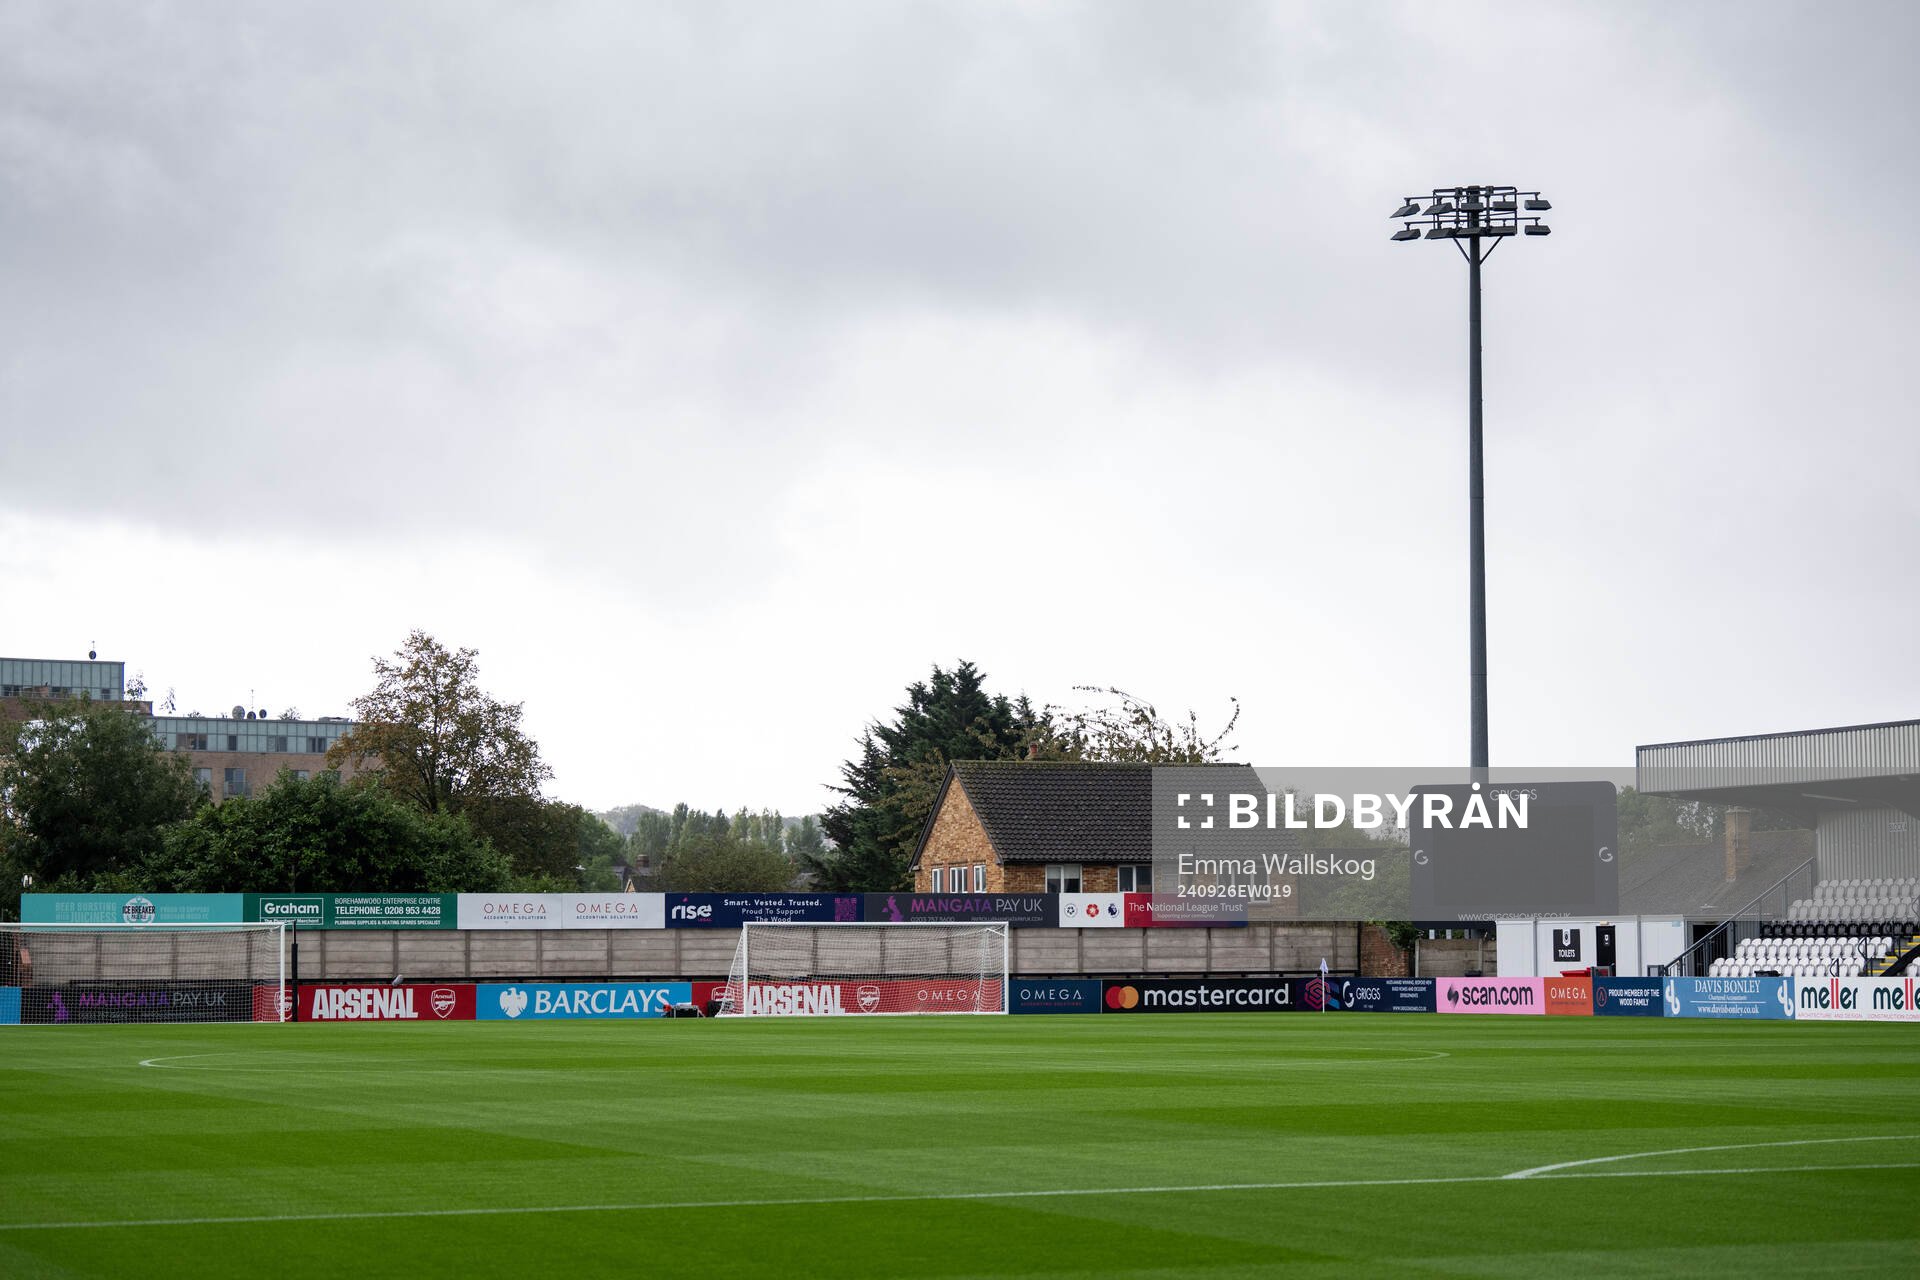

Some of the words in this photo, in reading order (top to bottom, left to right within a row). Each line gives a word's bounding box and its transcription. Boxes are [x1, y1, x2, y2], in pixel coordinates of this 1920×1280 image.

[131, 905, 156, 914] BREAKER
[264, 903, 319, 914] Graham
[336, 906, 383, 915] TELEPHONE:
[385, 906, 404, 915] 0208
[406, 906, 420, 915] 953
[421, 906, 441, 915] 4428
[484, 903, 547, 914] OMEGA
[576, 903, 638, 914] OMEGA
[672, 898, 712, 919] rise
[911, 899, 992, 912] MANGATA
[996, 899, 1020, 912] PAY
[1023, 899, 1042, 911] UK
[1129, 903, 1144, 911] The
[1146, 903, 1184, 911] National
[1187, 903, 1218, 913] League
[1220, 903, 1243, 911] Trust
[776, 908, 805, 916] Support
[1551, 987, 1587, 999] OMEGA
[1609, 989, 1623, 997] PROUD
[1624, 989, 1643, 997] MEMBER
[1644, 989, 1650, 997] OF
[1651, 989, 1660, 997] THE
[1695, 980, 1722, 993] DAVIS
[1724, 980, 1761, 994] BONLEY
[79, 992, 170, 1006] MANGATA
[173, 992, 200, 1006] PAY
[205, 992, 226, 1006] UK
[746, 985, 845, 1014] ARSENAL
[918, 990, 979, 1001] OMEGA
[1020, 989, 1082, 1000] OMEGA
[1144, 983, 1289, 1006] mastercard
[1355, 987, 1381, 1000] GRIGGS
[1462, 986, 1534, 1006] scan.com
[1801, 978, 1859, 1009] meller
[312, 988, 419, 1019] ARSENAL
[534, 989, 670, 1014] BARCLAYS
[1620, 998, 1632, 1006] WOOD
[1634, 998, 1649, 1006] FAMILY
